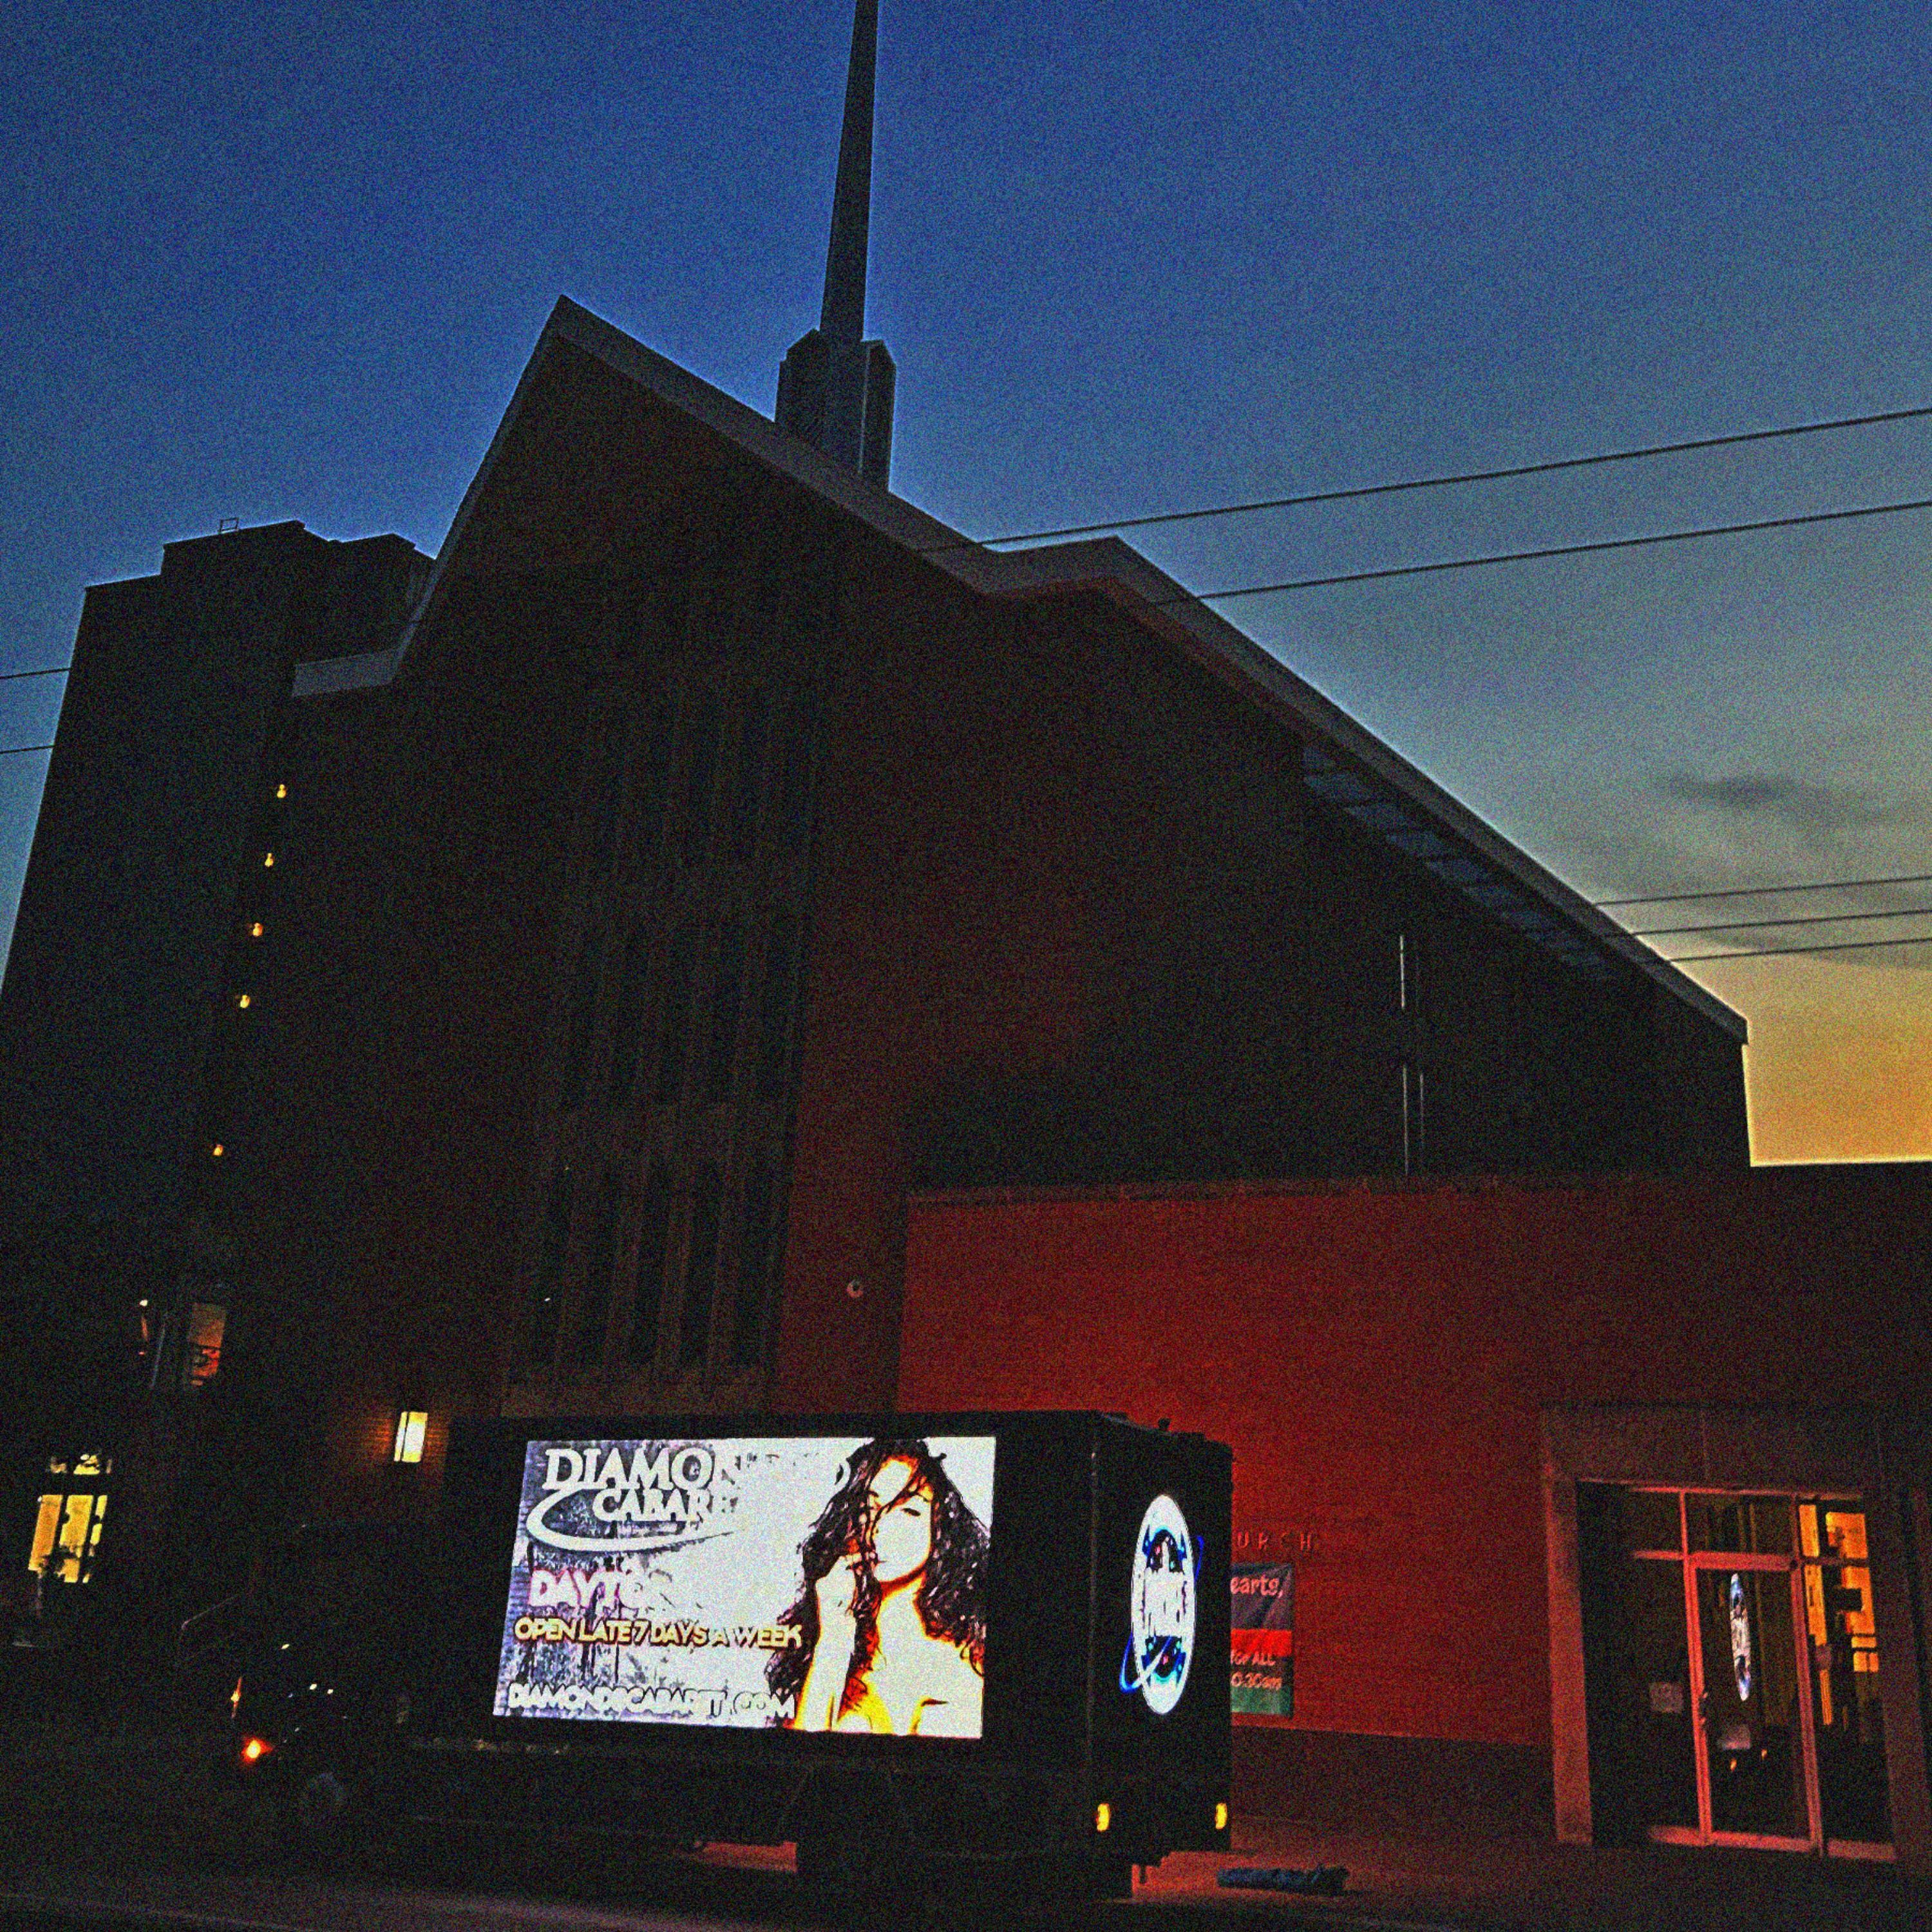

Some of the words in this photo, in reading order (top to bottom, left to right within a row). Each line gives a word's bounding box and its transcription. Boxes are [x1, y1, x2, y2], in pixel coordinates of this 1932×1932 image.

[544, 1447, 781, 1490] DIAMON
[592, 1485, 747, 1521] CABARE
[514, 1616, 578, 1642] OPEN
[578, 1619, 632, 1644] LATE
[632, 1620, 650, 1645] 7
[650, 1622, 709, 1647] DAYS
[710, 1627, 730, 1647] A
[730, 1624, 802, 1649] WEEK
